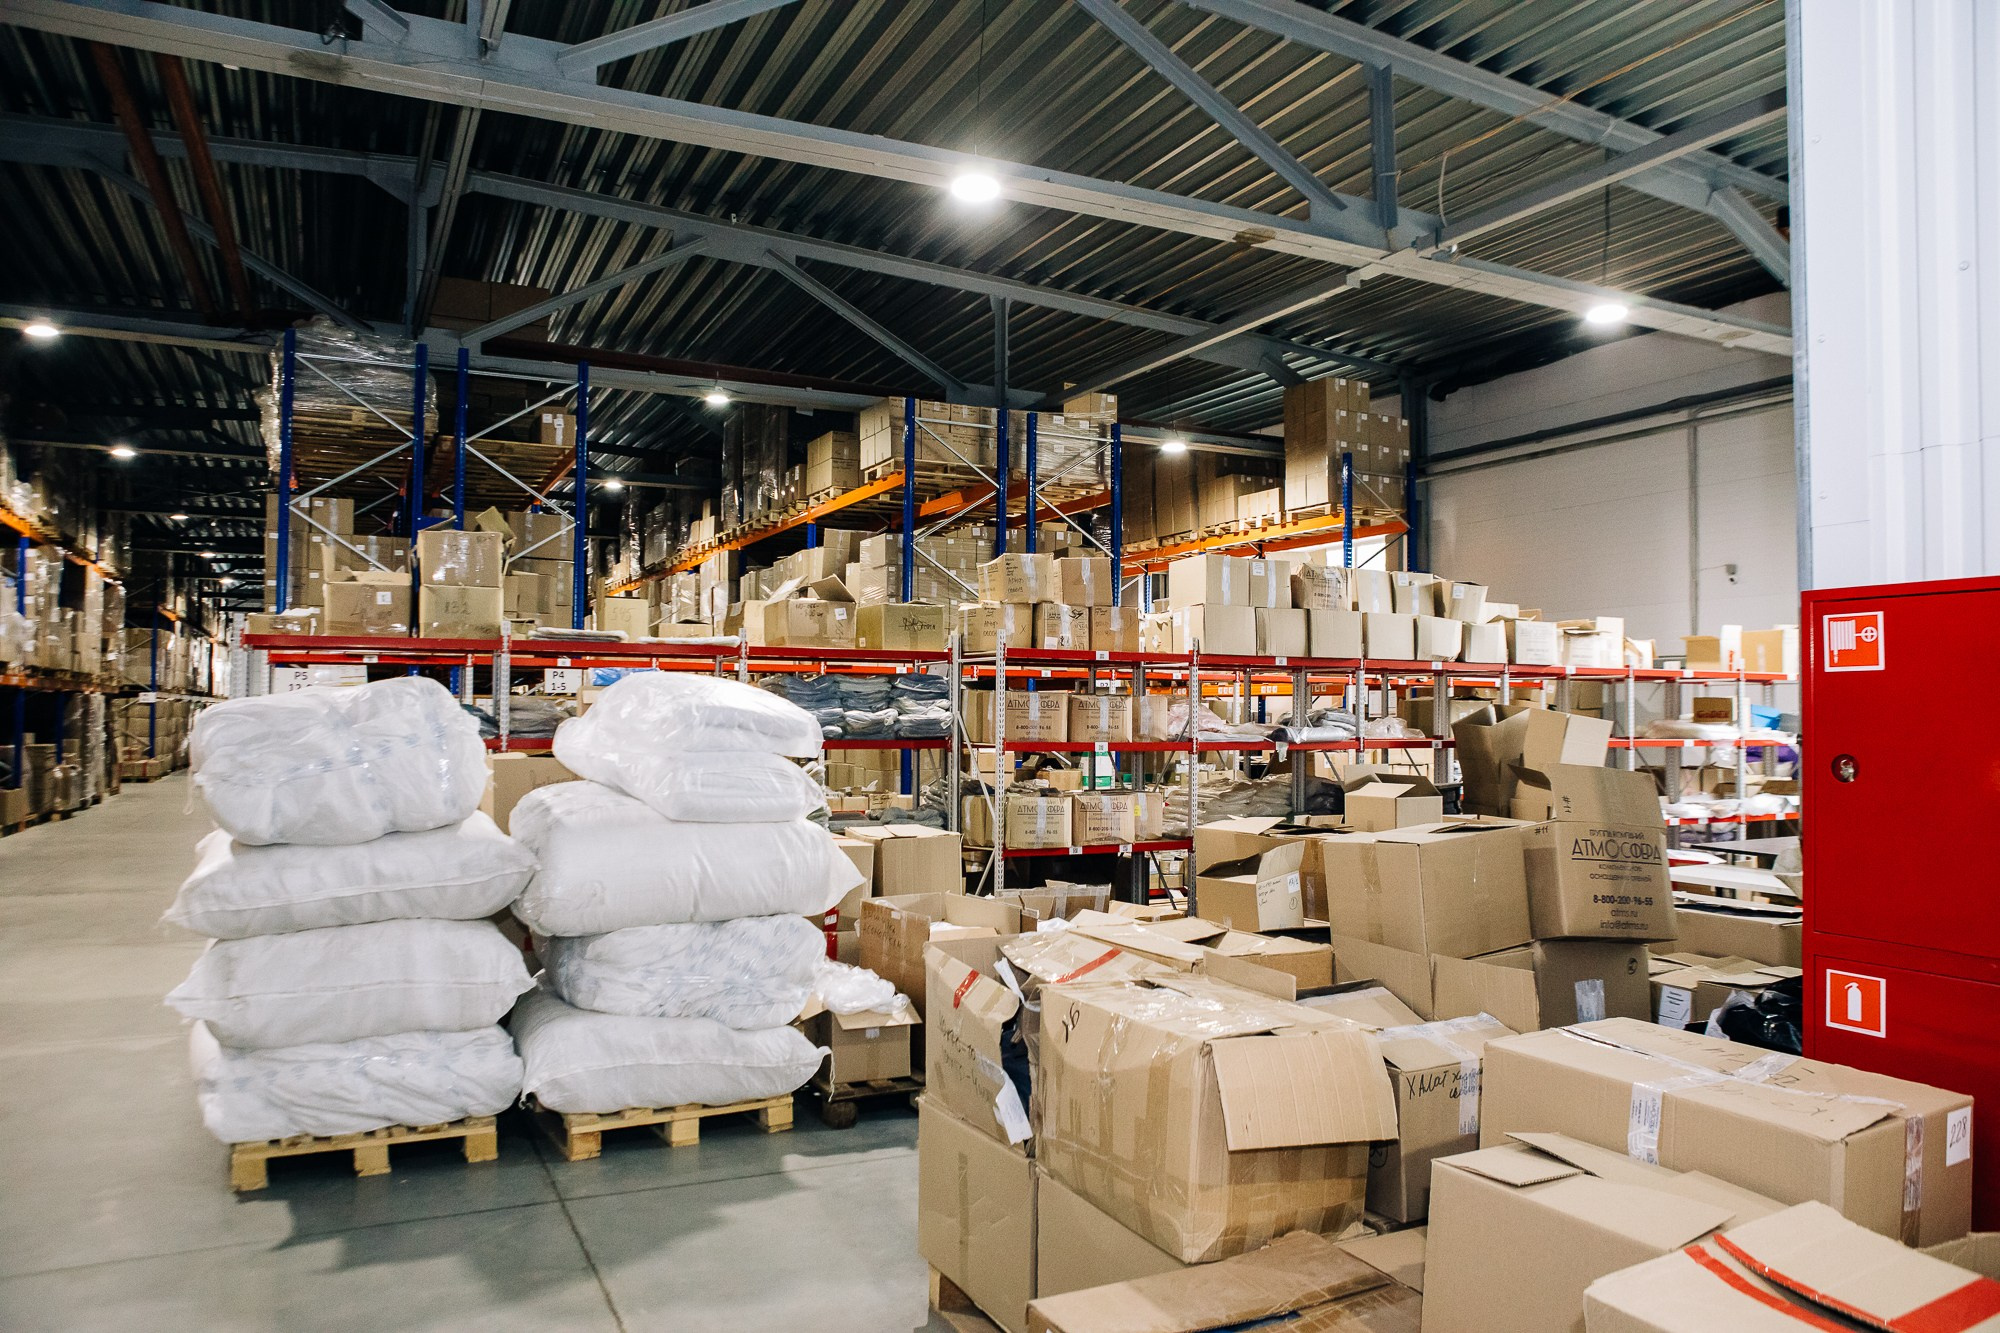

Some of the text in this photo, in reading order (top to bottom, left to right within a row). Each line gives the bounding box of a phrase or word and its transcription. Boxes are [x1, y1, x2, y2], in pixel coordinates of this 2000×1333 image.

[1007, 699, 1060, 709] АТМФЕРА
[1078, 700, 1127, 709] АТМФЕРА
[1017, 804, 1065, 814] АТМФЕРА
[1079, 801, 1128, 811] АТМОФЕРА
[1571, 837, 1662, 861] АТМОСФЕРА
[1593, 894, 1654, 906] 8-800-200-96-55
[1949, 1115, 1968, 1149] 228
